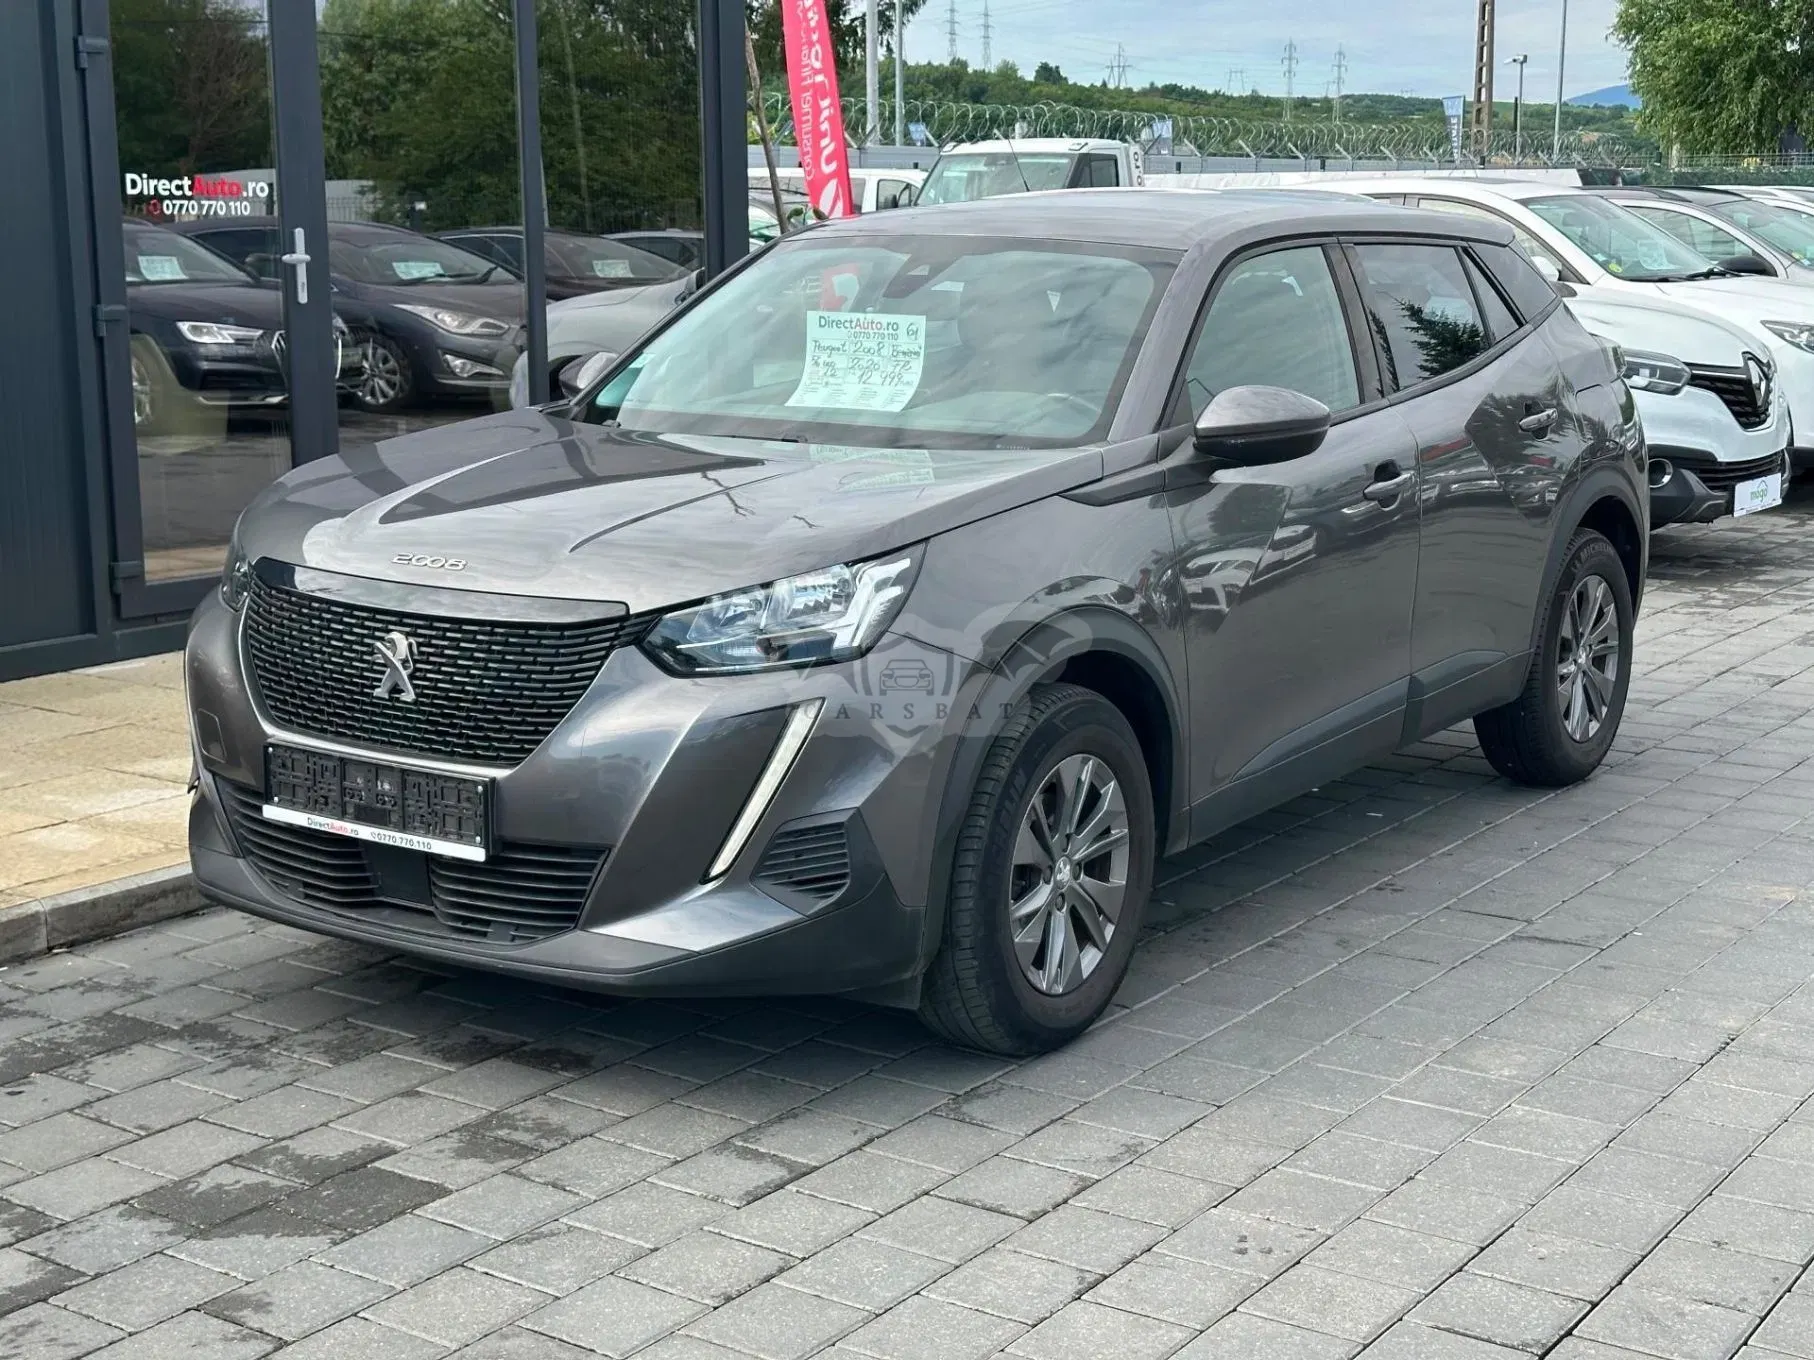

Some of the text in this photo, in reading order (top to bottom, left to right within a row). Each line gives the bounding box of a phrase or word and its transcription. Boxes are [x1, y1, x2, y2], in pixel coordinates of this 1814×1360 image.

[124, 172, 269, 198] DirectAuto.ro
[162, 200, 251, 216] 0770 770 110
[818, 315, 900, 332] DirectAuto.ro
[853, 331, 871, 340] 0770
[872, 332, 886, 340] 770
[391, 552, 468, 571] 2008
[307, 816, 360, 836] DirectAuto.ro
